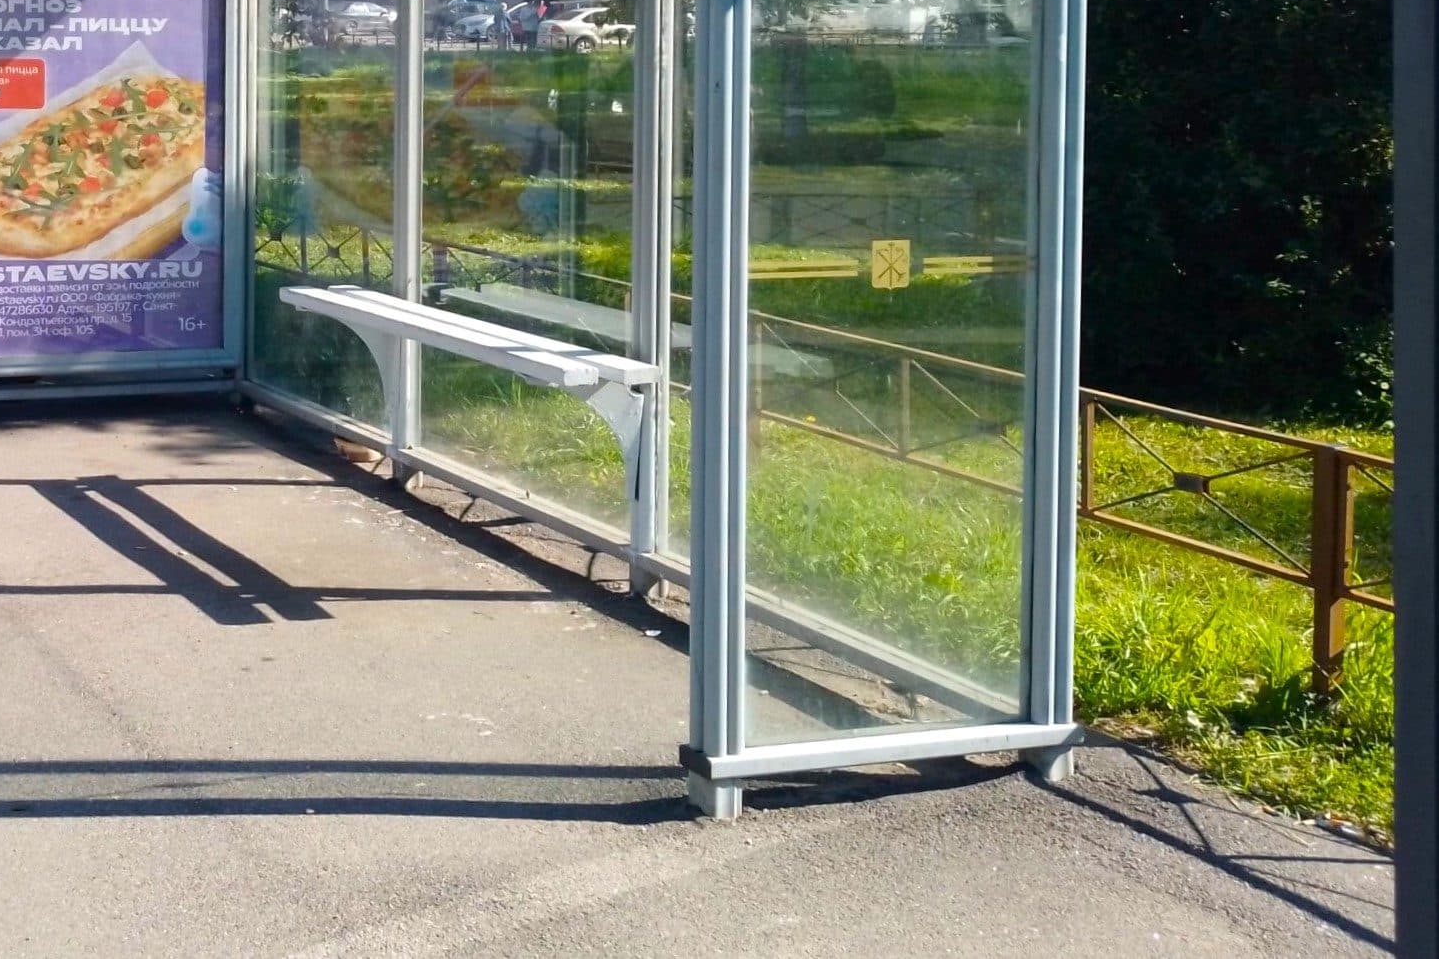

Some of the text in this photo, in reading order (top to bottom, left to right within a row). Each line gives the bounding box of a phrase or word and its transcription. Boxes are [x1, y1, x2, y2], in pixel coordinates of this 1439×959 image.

[68, 17, 168, 35] ПИЦЦУ
[5, 65, 39, 75] пицца
[91, 283, 104, 291] от
[60, 292, 88, 302] ООО
[122, 312, 133, 323] 15
[178, 316, 207, 332] 16+
